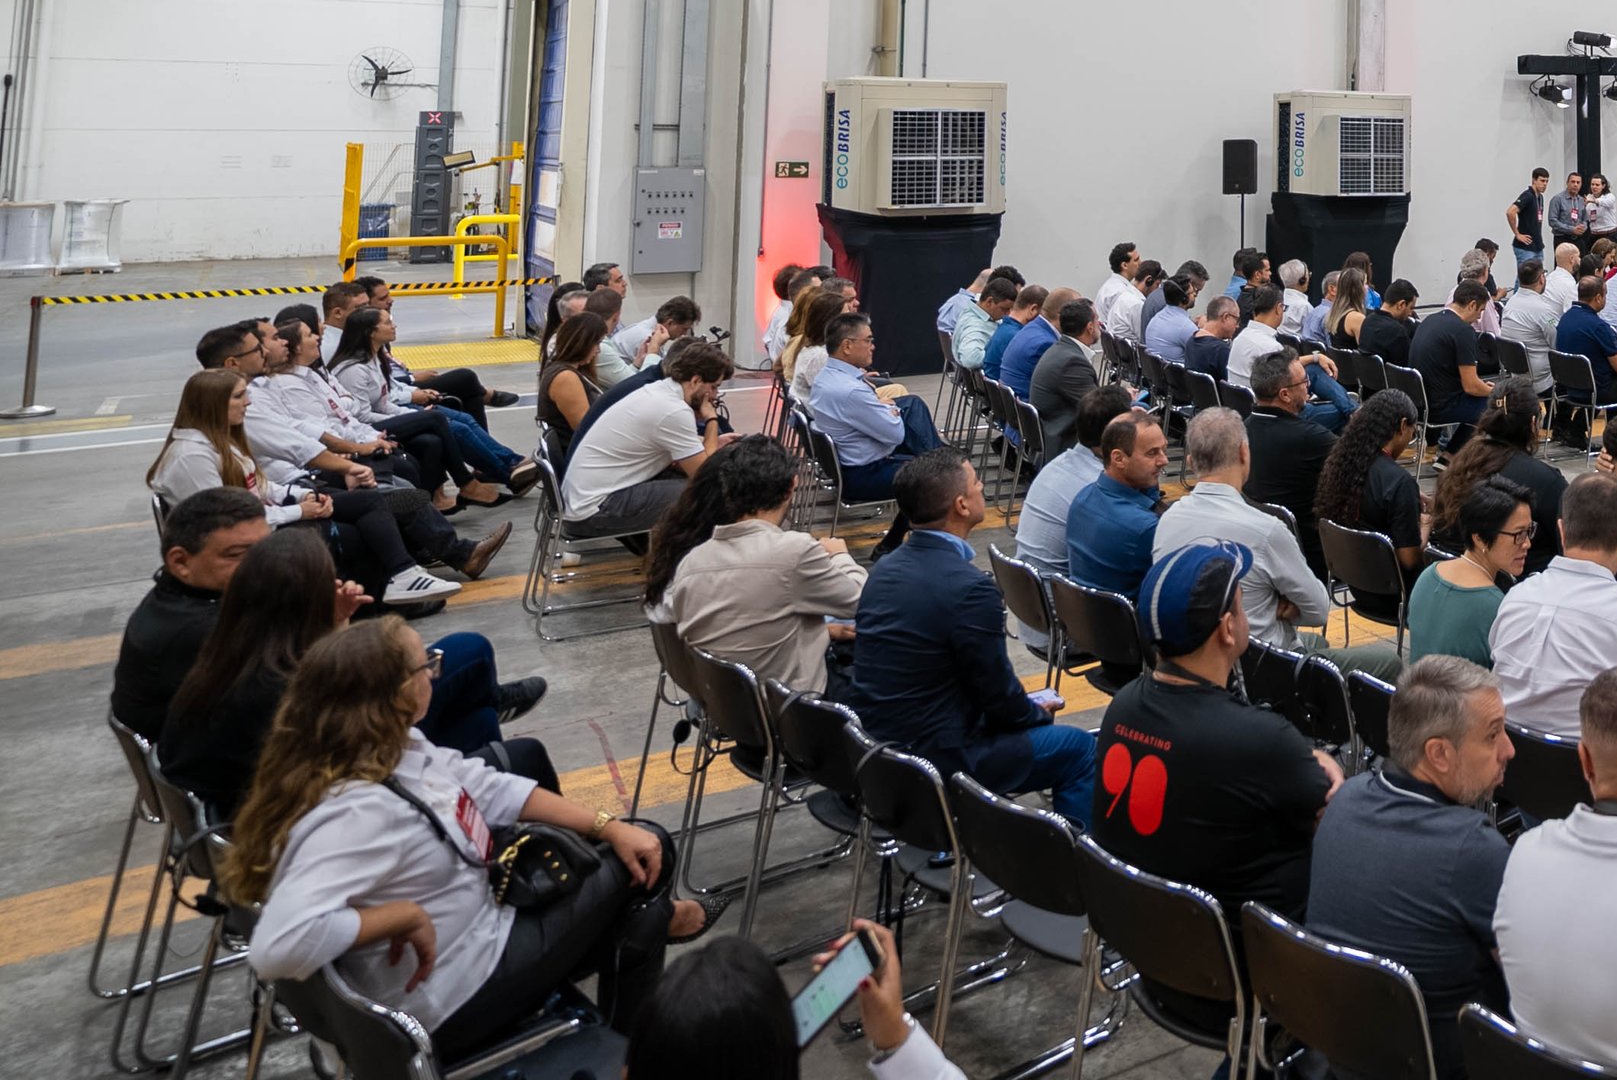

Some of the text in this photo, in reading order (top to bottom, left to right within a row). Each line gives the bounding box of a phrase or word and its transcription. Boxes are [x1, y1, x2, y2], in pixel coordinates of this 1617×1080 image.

[836, 109, 850, 189] ecoBRISA
[1293, 112, 1305, 177] ecoBRISA
[1114, 723, 1172, 752] CELEBRATING
[1102, 742, 1168, 837] 90
